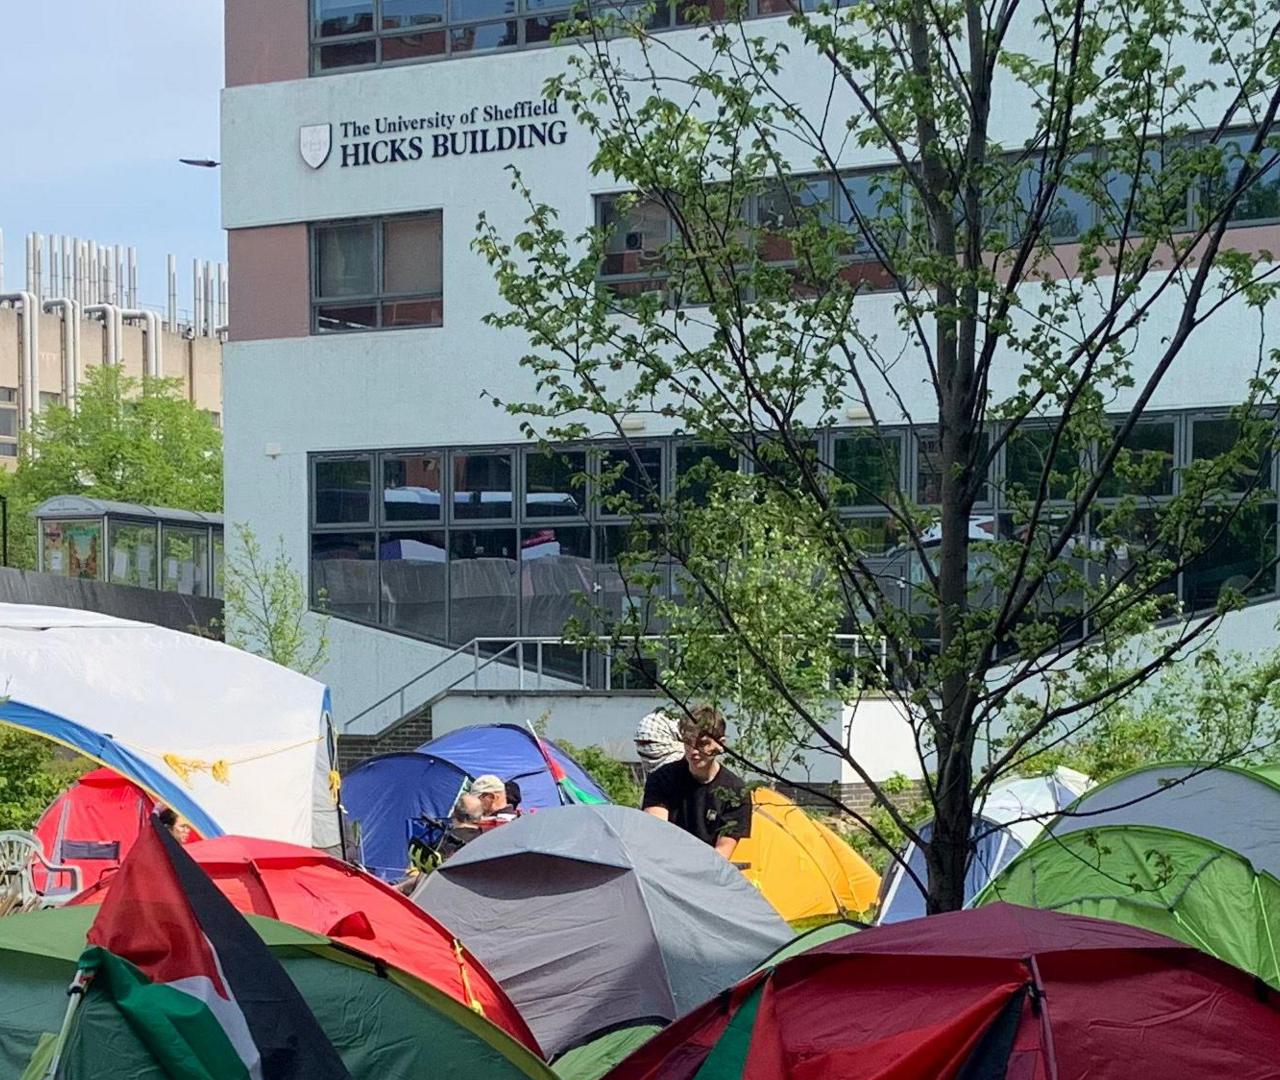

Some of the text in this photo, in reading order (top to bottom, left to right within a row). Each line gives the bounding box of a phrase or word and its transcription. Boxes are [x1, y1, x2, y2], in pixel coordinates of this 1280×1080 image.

[340, 98, 559, 138] The University of Sheffield
[340, 120, 568, 168] HICKS BUILDING
